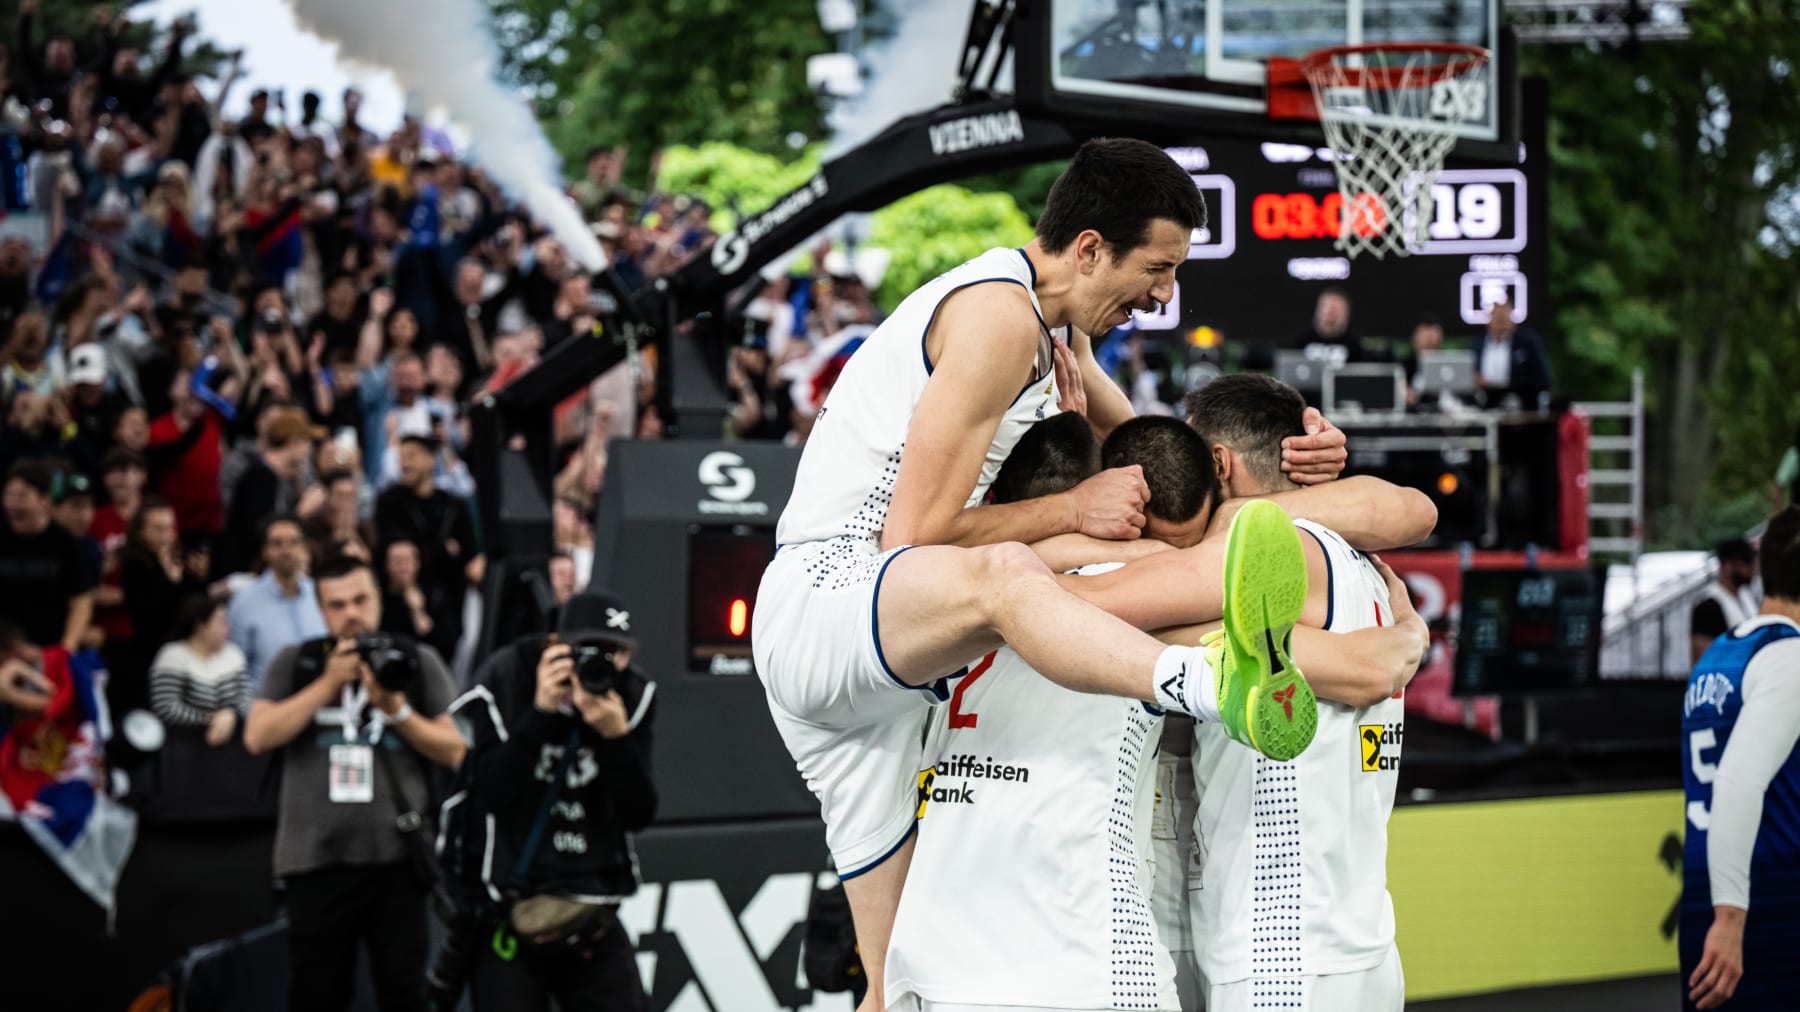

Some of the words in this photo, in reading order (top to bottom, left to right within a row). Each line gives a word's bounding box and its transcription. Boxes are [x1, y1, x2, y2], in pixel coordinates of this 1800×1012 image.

[929, 109, 1024, 154] VIENNA
[1429, 183, 1501, 239] 19
[935, 754, 1029, 783] aiffeisen
[931, 781, 975, 804] ank
